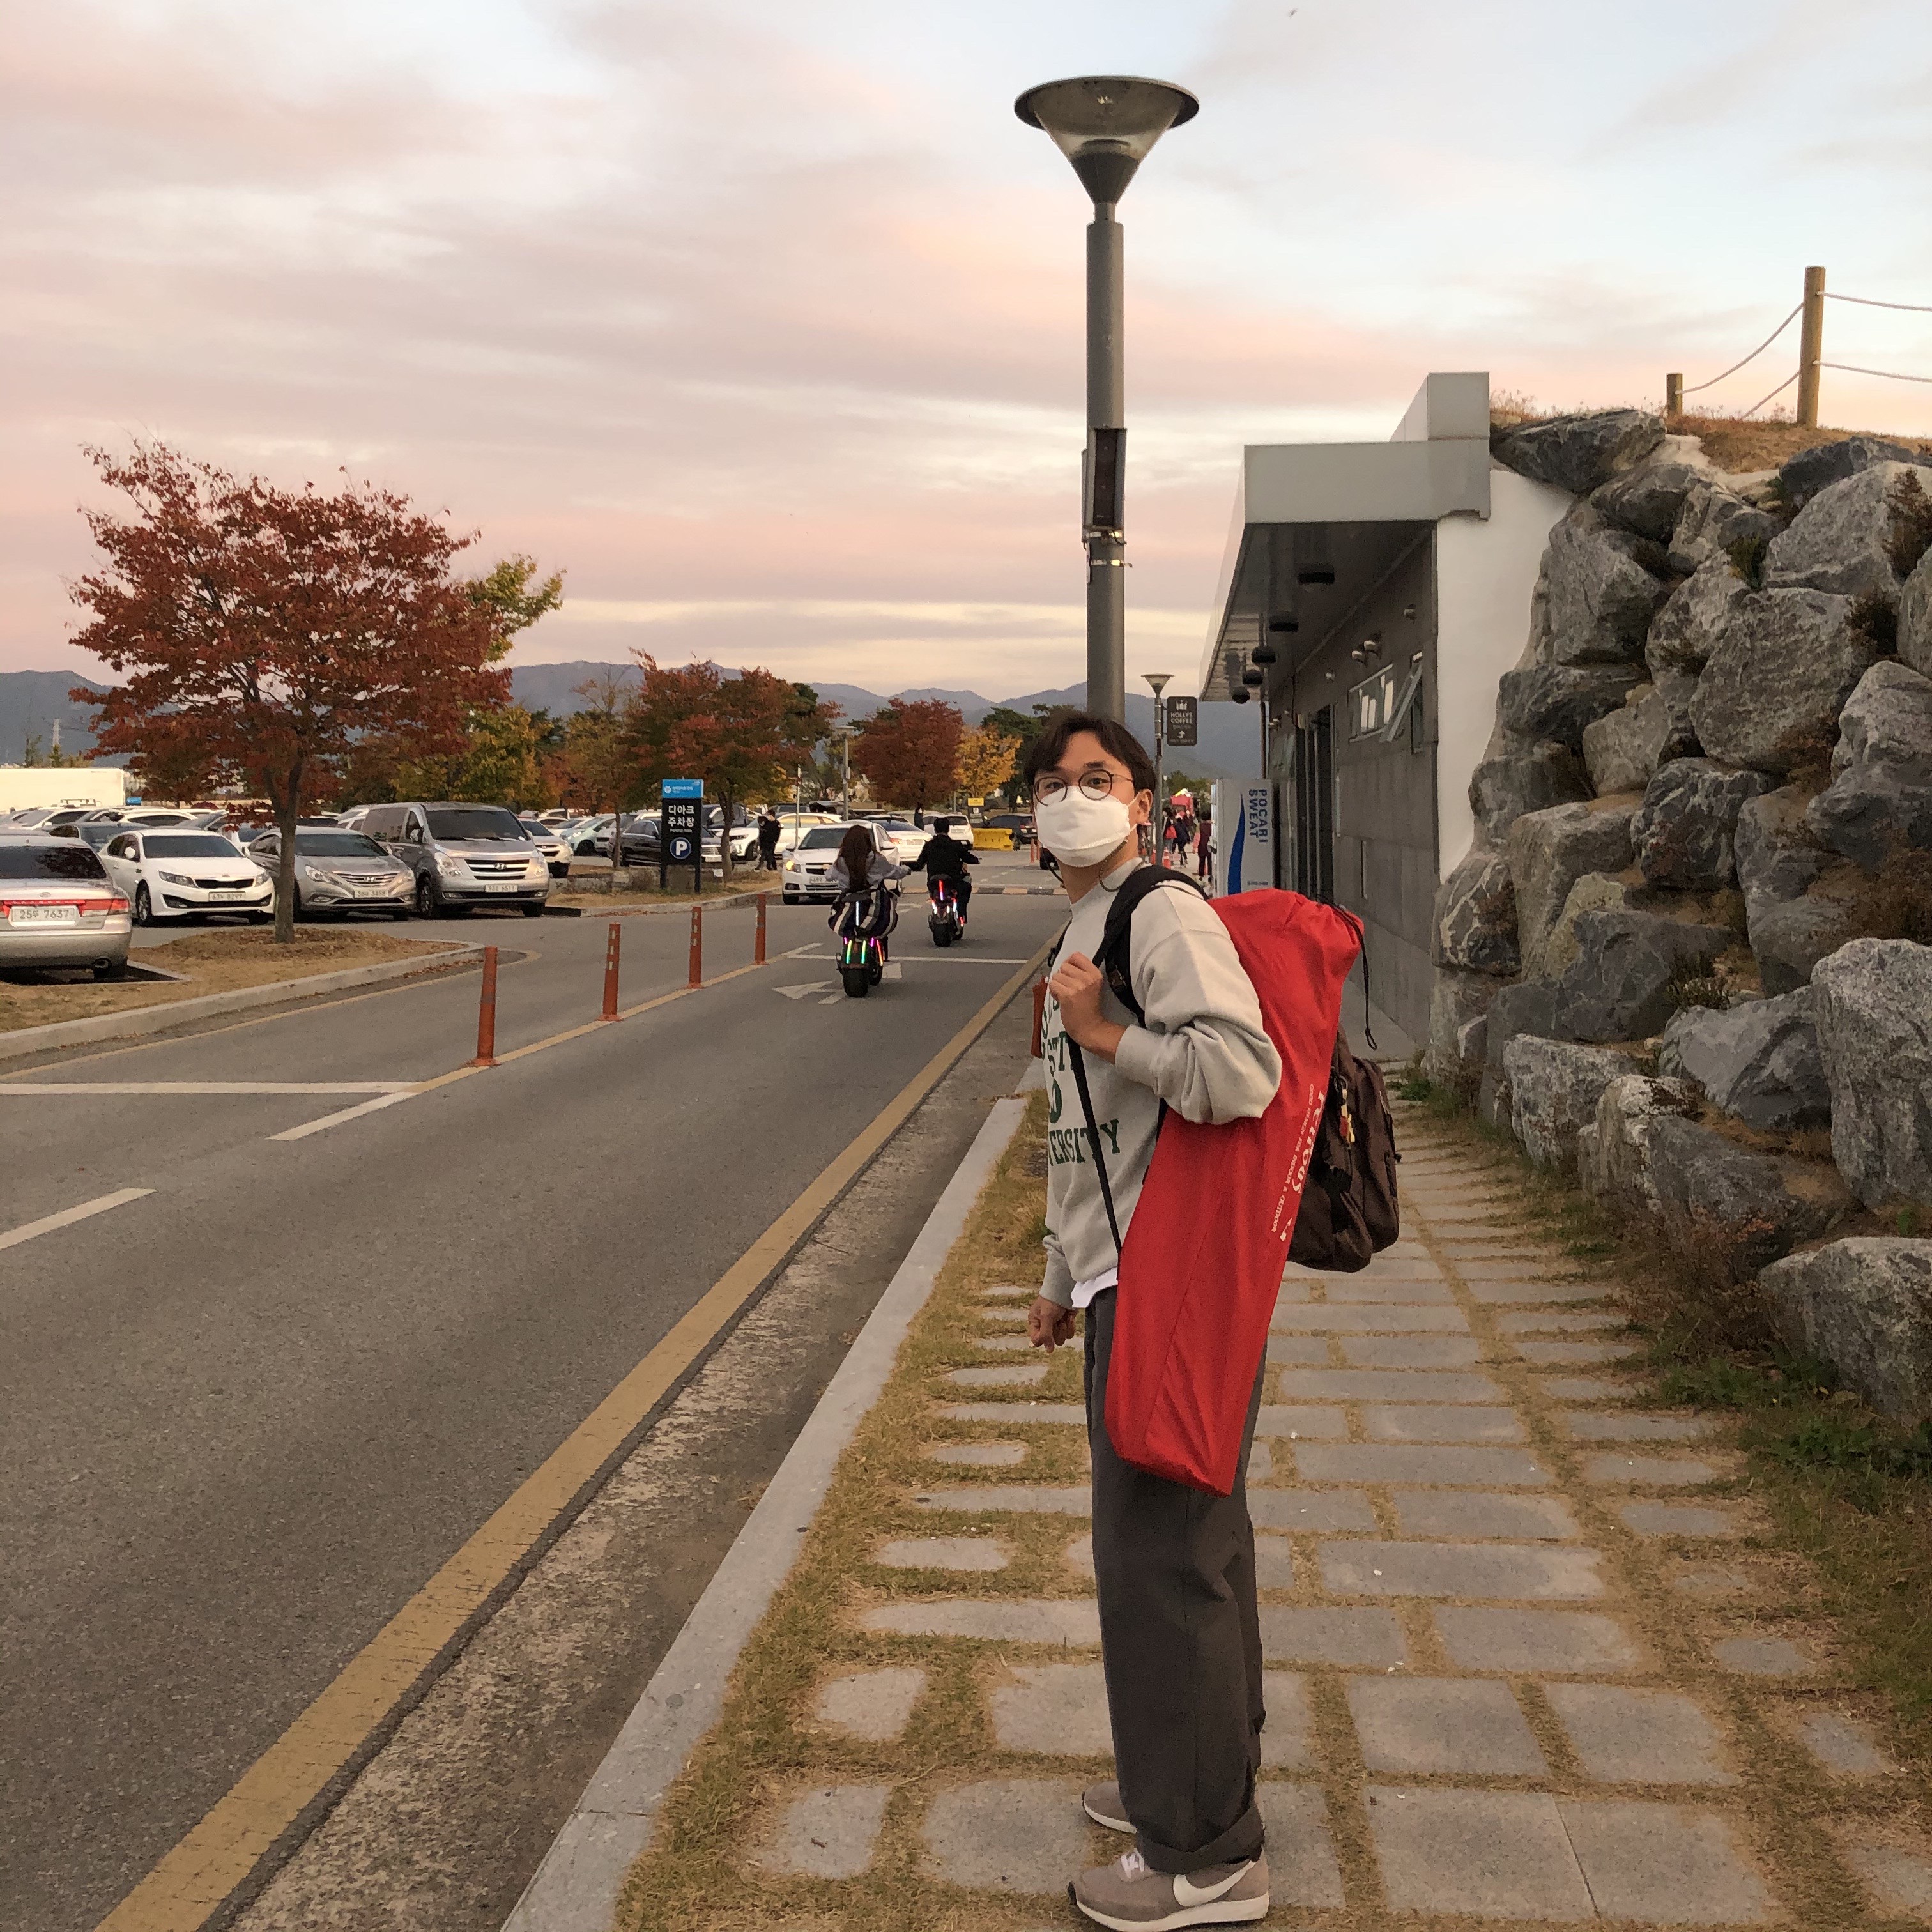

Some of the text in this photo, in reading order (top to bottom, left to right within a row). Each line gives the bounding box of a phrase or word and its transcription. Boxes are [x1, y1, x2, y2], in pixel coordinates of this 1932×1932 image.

[668, 804, 695, 815] 디아크
[1248, 788, 1259, 838] SWEAT
[1259, 788, 1268, 843] POCARI
[668, 816, 695, 827] 주차장
[676, 840, 687, 856] P
[43, 909, 69, 919] 7637
[1294, 1137, 1303, 1152] FOR
[1285, 1154, 1298, 1184] INDOOR
[1271, 1195, 1285, 1232] OUTDOOR
